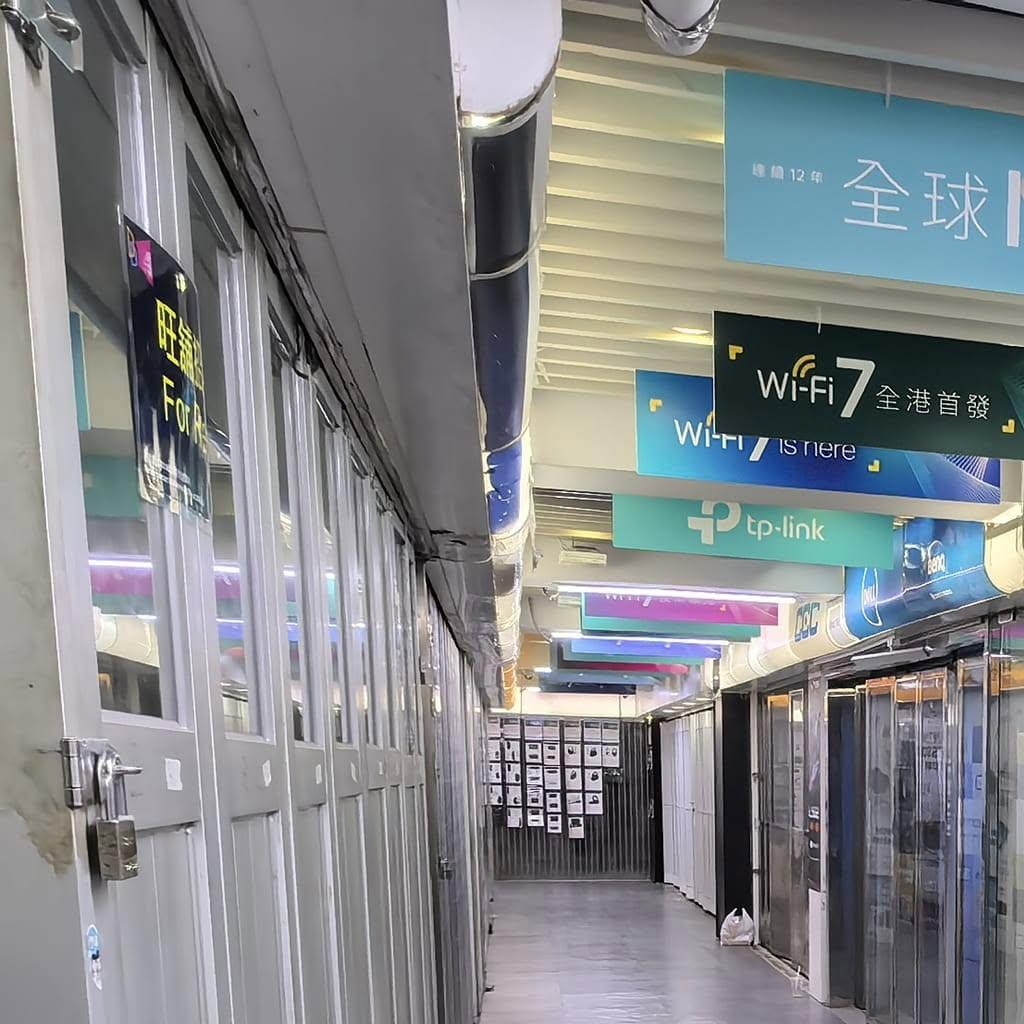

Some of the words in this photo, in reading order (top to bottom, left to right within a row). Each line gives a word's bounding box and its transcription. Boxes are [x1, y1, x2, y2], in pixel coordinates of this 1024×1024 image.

[842, 158, 990, 241] 全球
[162, 374, 191, 437] For
[757, 369, 834, 406] Wi-Fi
[836, 356, 876, 418] 7
[875, 384, 990, 420] 全港首發
[746, 513, 825, 541] tp-link
